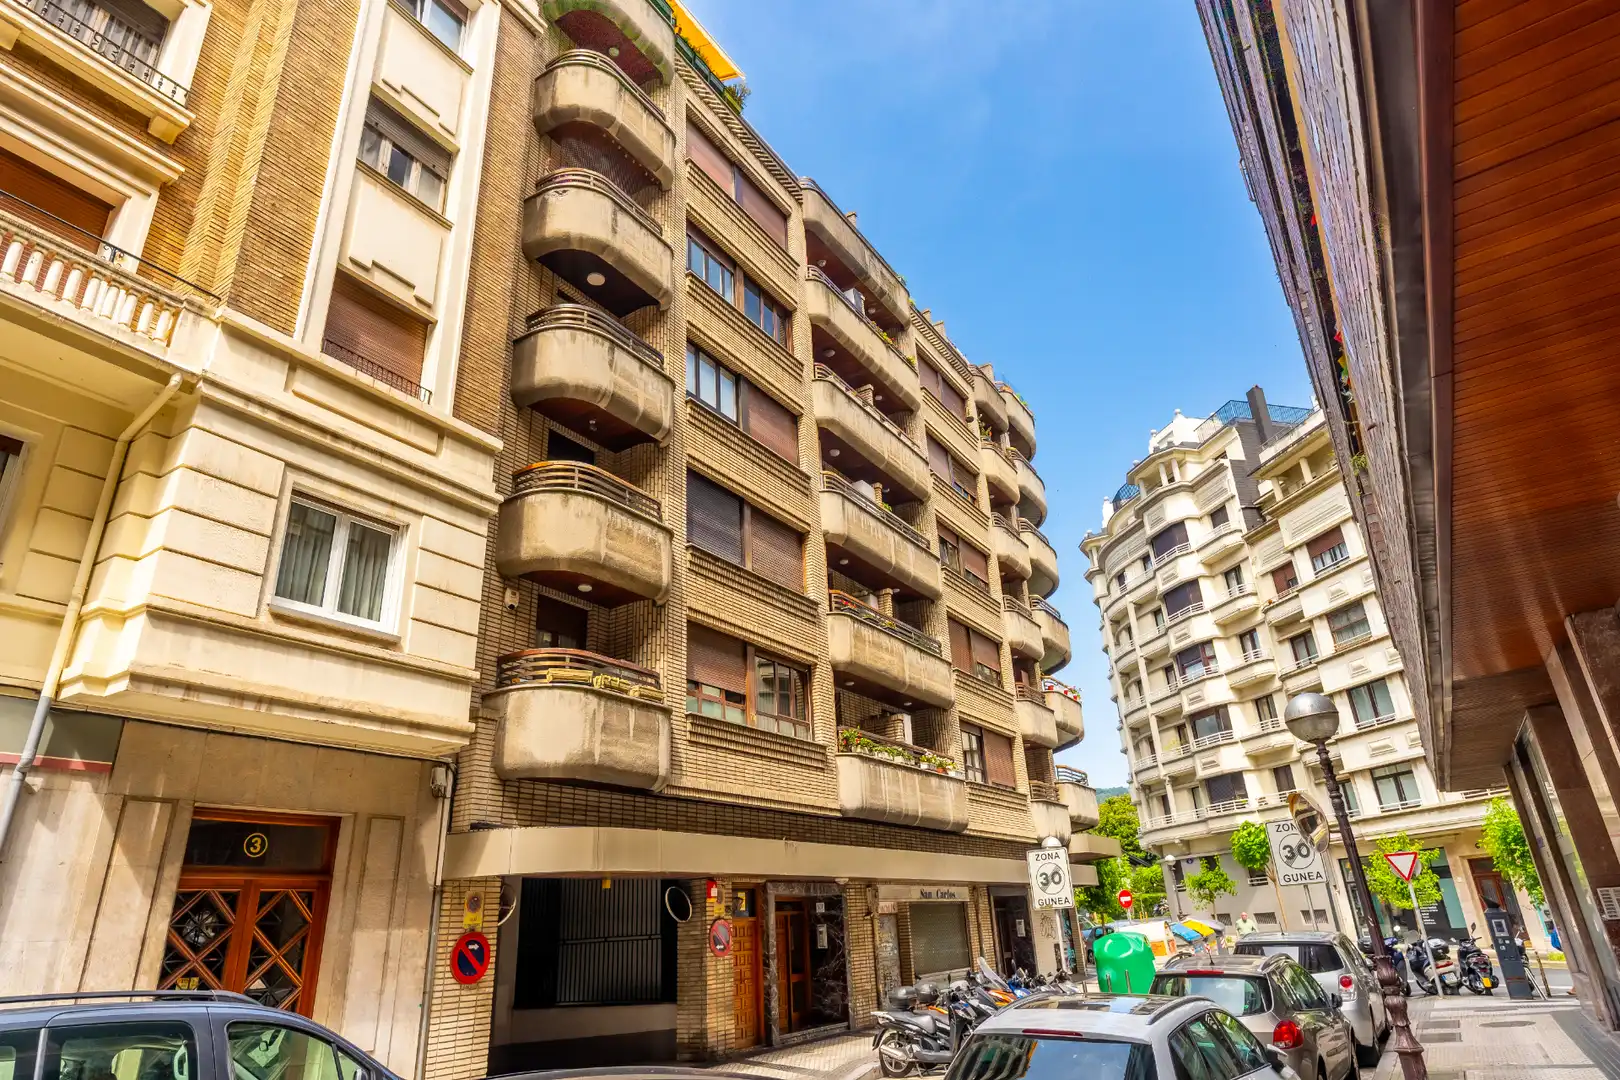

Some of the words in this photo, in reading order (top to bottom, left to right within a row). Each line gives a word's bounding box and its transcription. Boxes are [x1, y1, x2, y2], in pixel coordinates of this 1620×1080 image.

[1275, 822, 1298, 833] ZON
[250, 837, 261, 853] 3
[1035, 852, 1061, 862] ZONA
[1282, 842, 1311, 861] 30
[1039, 871, 1062, 887] 30
[1283, 871, 1324, 883] GUNEA
[920, 888, 933, 899] San
[936, 888, 956, 899] Carlos
[1038, 896, 1070, 907] GUNEA
